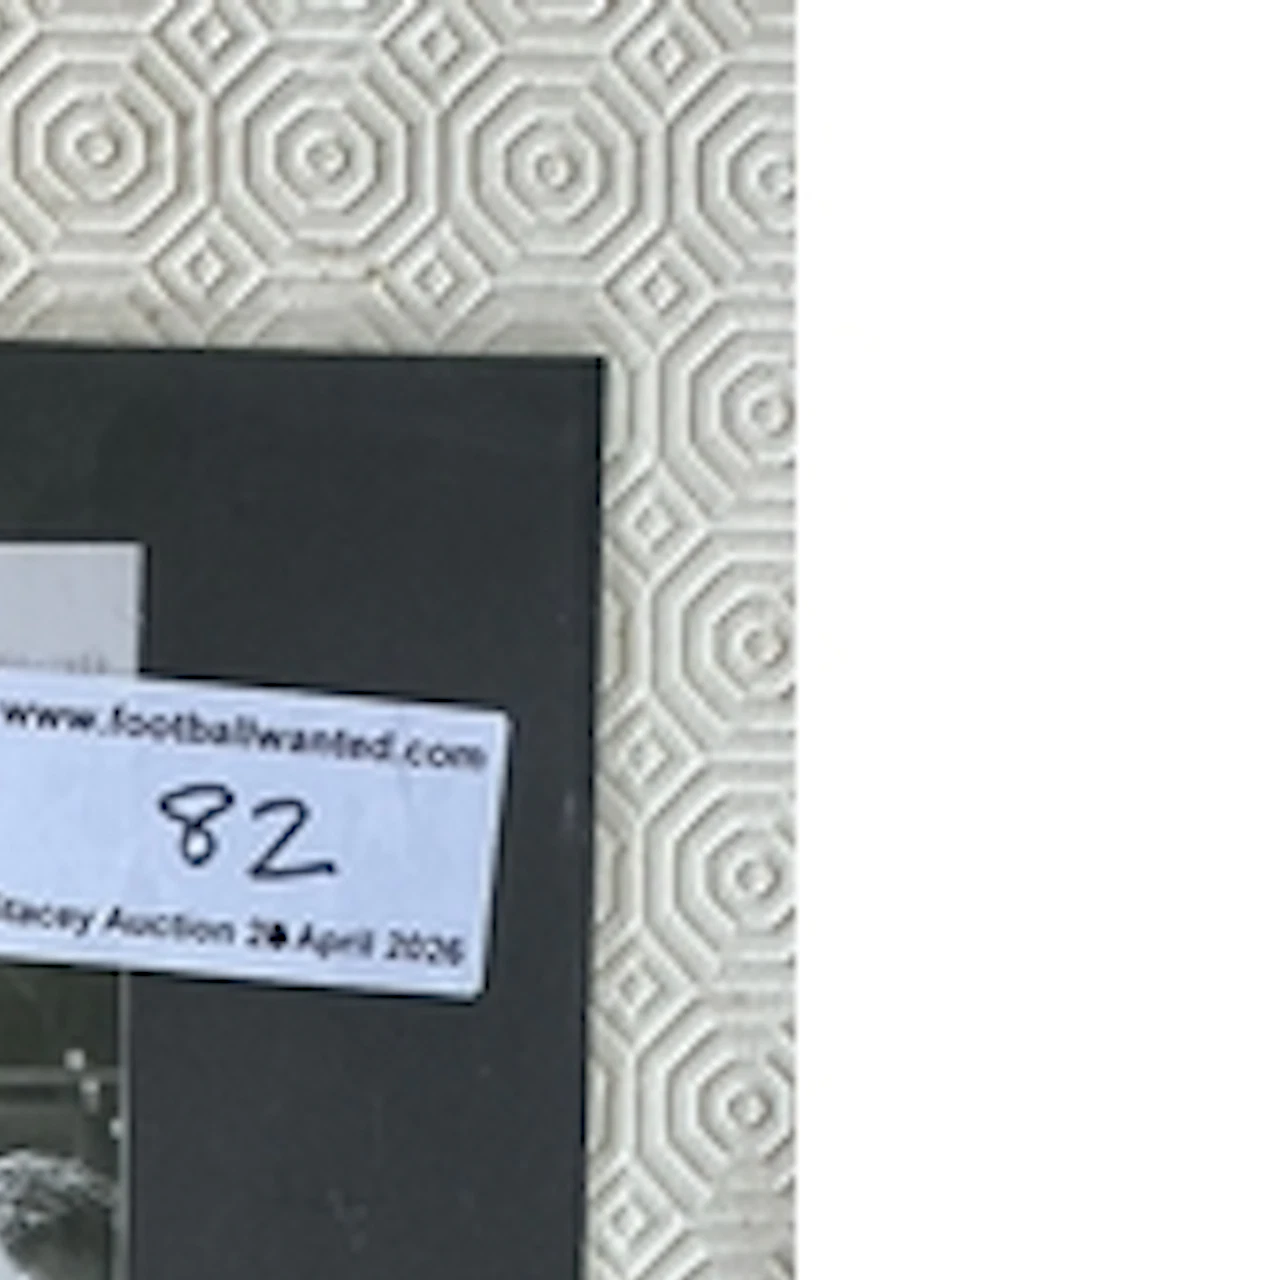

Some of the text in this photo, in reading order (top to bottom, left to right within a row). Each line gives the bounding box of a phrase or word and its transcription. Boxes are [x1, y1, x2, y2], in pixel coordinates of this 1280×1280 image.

[0, 699, 488, 770] www.footballwanted.com
[158, 783, 337, 882] 82
[102, 907, 235, 945] Auction
[297, 921, 373, 960] April
